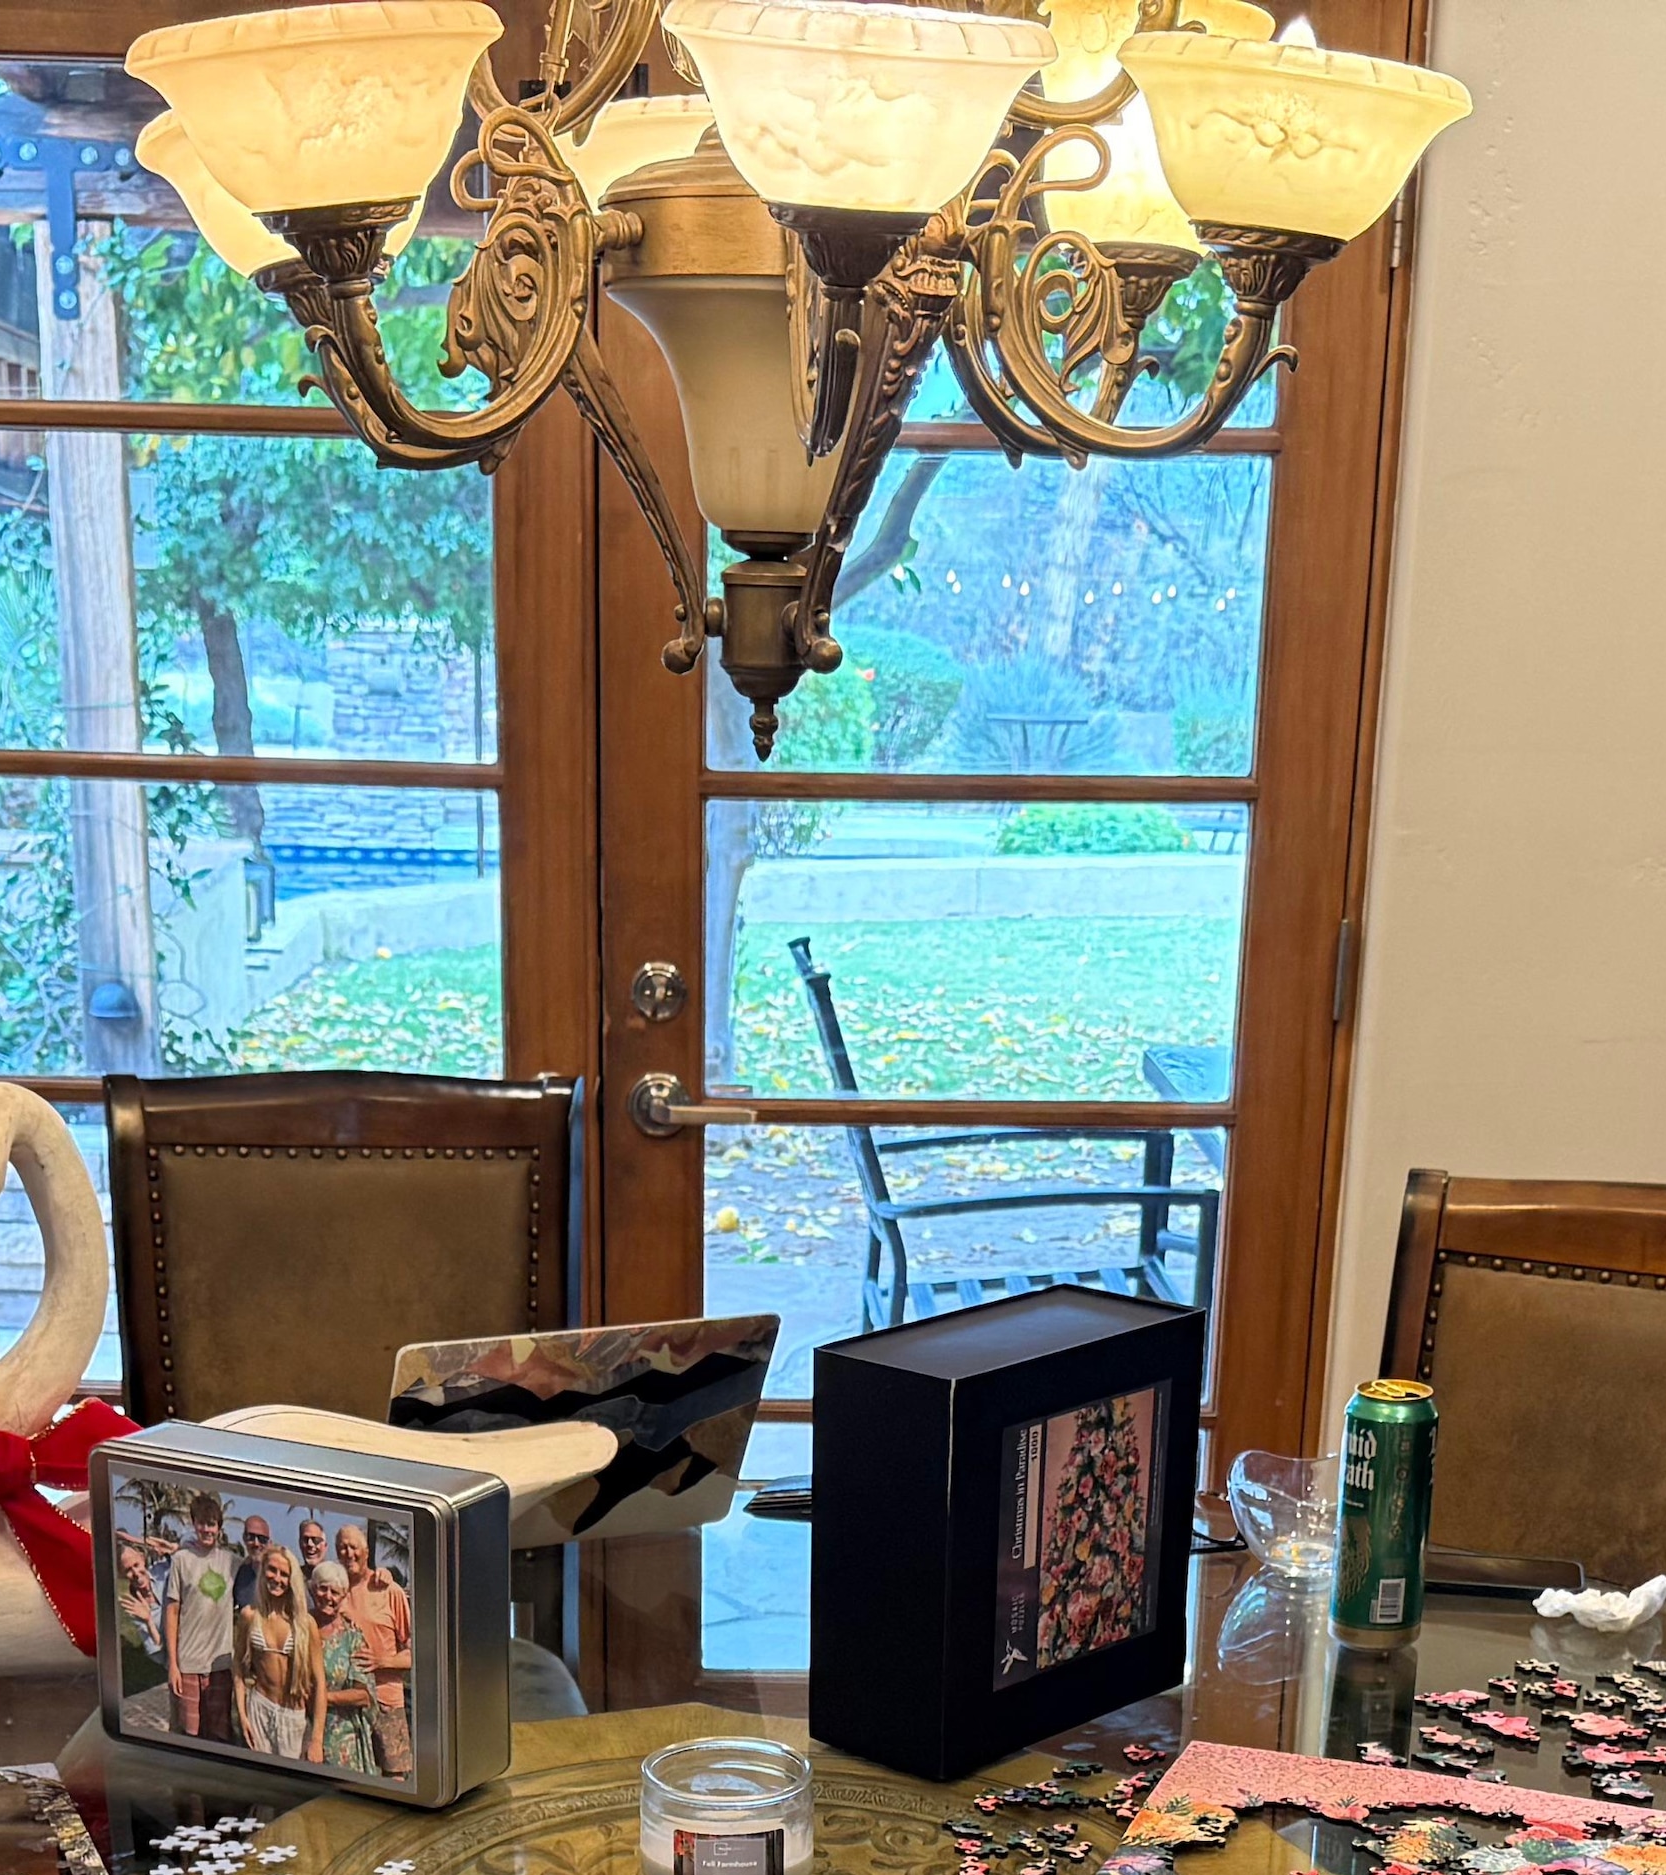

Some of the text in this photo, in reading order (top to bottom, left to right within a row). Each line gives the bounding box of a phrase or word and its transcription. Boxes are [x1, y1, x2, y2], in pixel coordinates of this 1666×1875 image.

[1030, 1430, 1039, 1462] 1000
[1348, 1424, 1378, 1460] uid
[1346, 1460, 1375, 1491] ath
[1012, 1429, 1029, 1560] Christmas in Paradise
